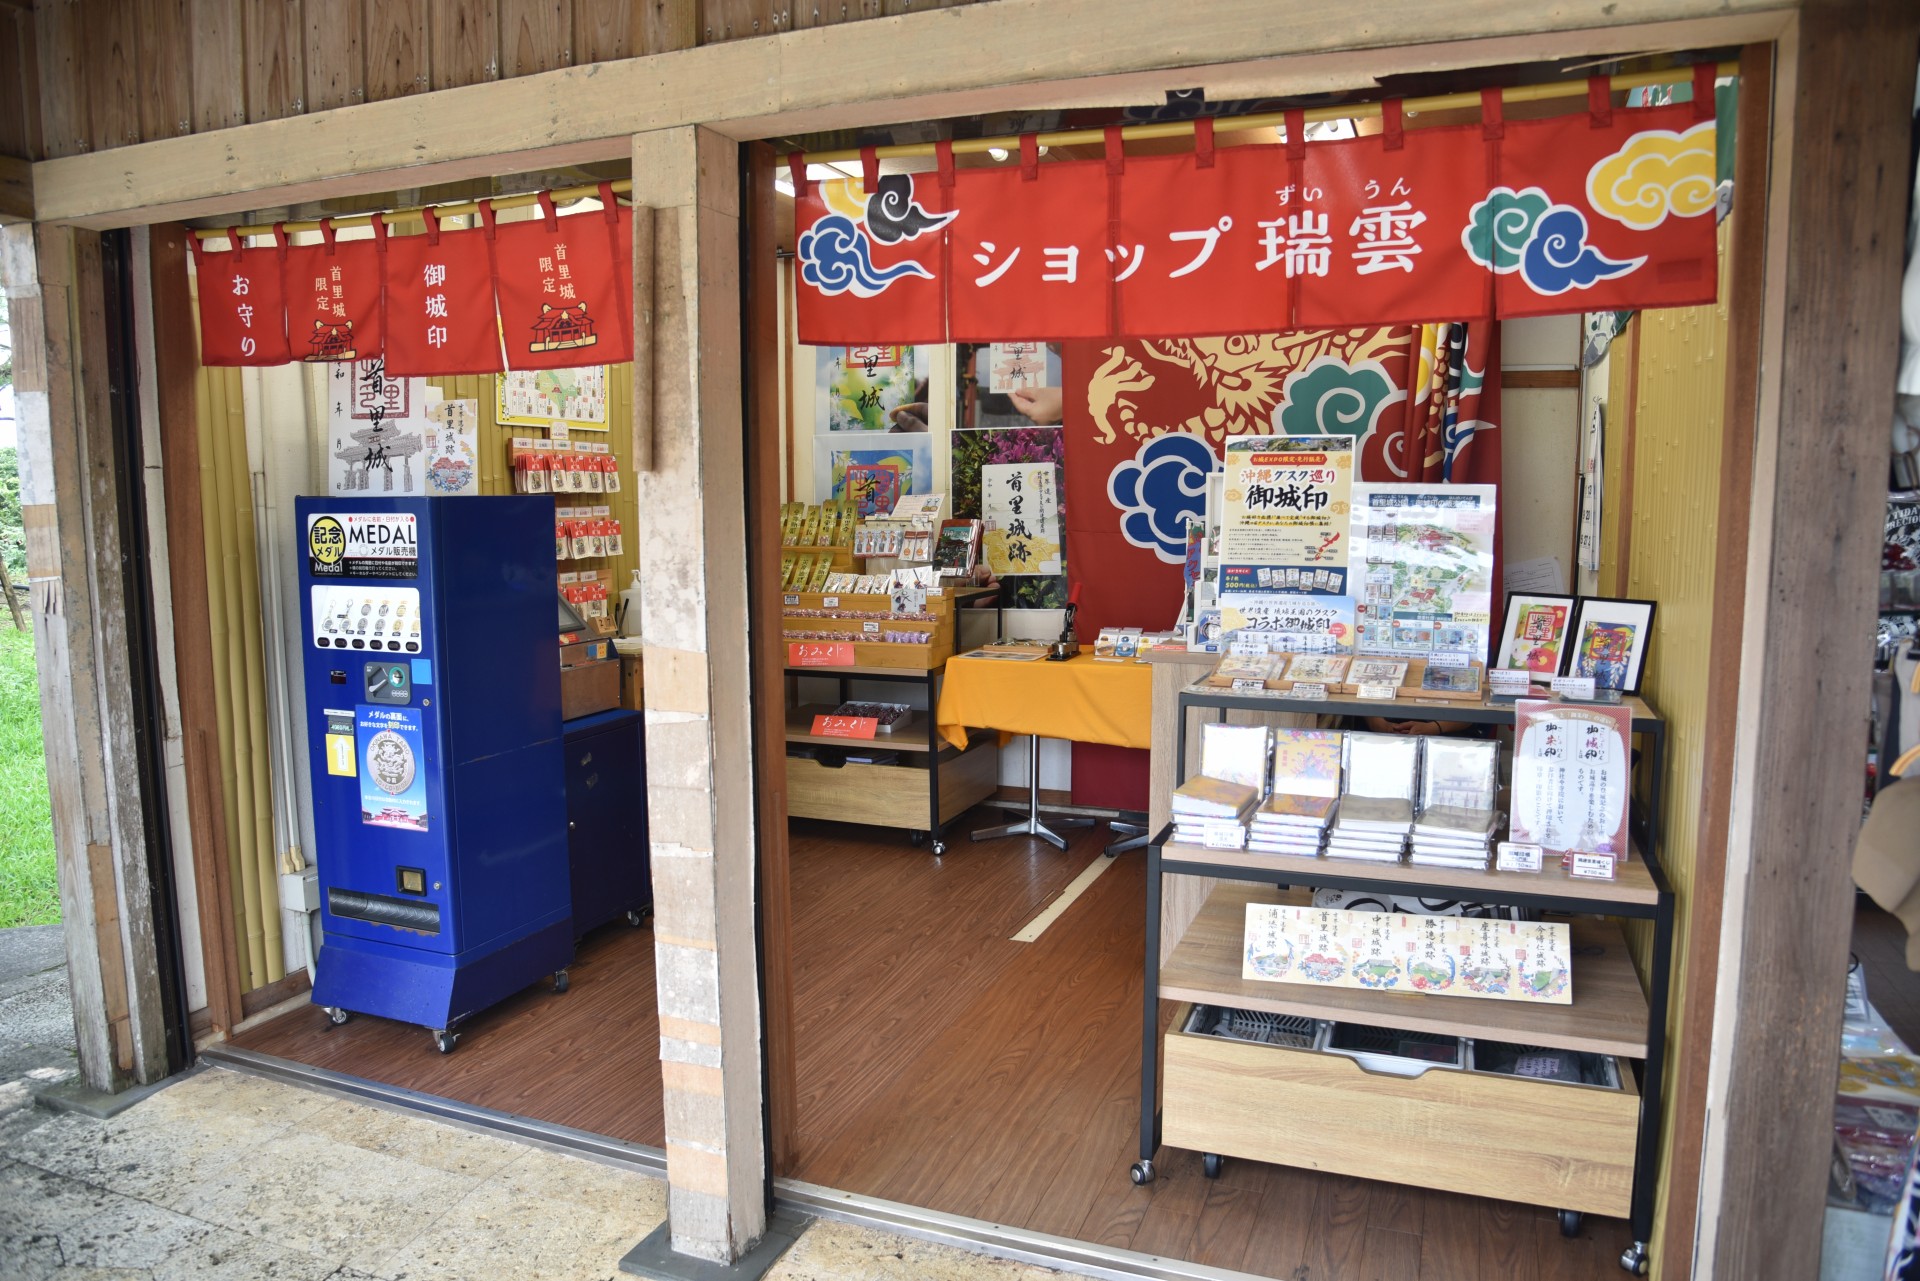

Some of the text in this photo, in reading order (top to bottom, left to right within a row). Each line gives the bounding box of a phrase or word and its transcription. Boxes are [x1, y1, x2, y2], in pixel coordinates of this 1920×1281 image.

[1275, 184, 1323, 207] ずい
[1364, 176, 1412, 198] うん
[538, 256, 556, 294] 限定
[554, 243, 576, 300] 首里城
[315, 277, 330, 311] 限定
[329, 265, 346, 318] 首里城
[423, 263, 448, 349] 御城印
[232, 273, 256, 358] お守り
[363, 358, 394, 472] 首里城
[444, 403, 456, 456] 首里城跡
[1043, 470, 1052, 504] 世界遺産
[1241, 469, 1336, 484] 沖縄グスク巡り
[1245, 483, 1328, 512] 御城印
[1006, 470, 1033, 563] 首里城跡
[313, 526, 342, 545] 記念
[316, 545, 343, 558] メダル
[349, 524, 416, 545] MEDAL
[371, 546, 417, 557] メダル販売機
[314, 560, 343, 573] Medal
[1240, 606, 1338, 617] 世界遺産 琉球王国のグスク
[1246, 617, 1331, 632] コラボ御城印
[798, 644, 844, 658] おみくじ
[822, 716, 867, 730] おみくじ
[1544, 722, 1558, 758] 御朱印
[370, 733, 393, 752] OKINAWA
[1585, 724, 1599, 760] 御城印
[1267, 908, 1278, 948] 浦添城跡
[1319, 911, 1329, 953] 首里城跡
[1371, 915, 1382, 956] 中城城跡
[1425, 919, 1437, 960] 勝連城跡
[1480, 922, 1490, 966] 座喜味城跡
[1536, 925, 1546, 967] 今帰仁城跡
